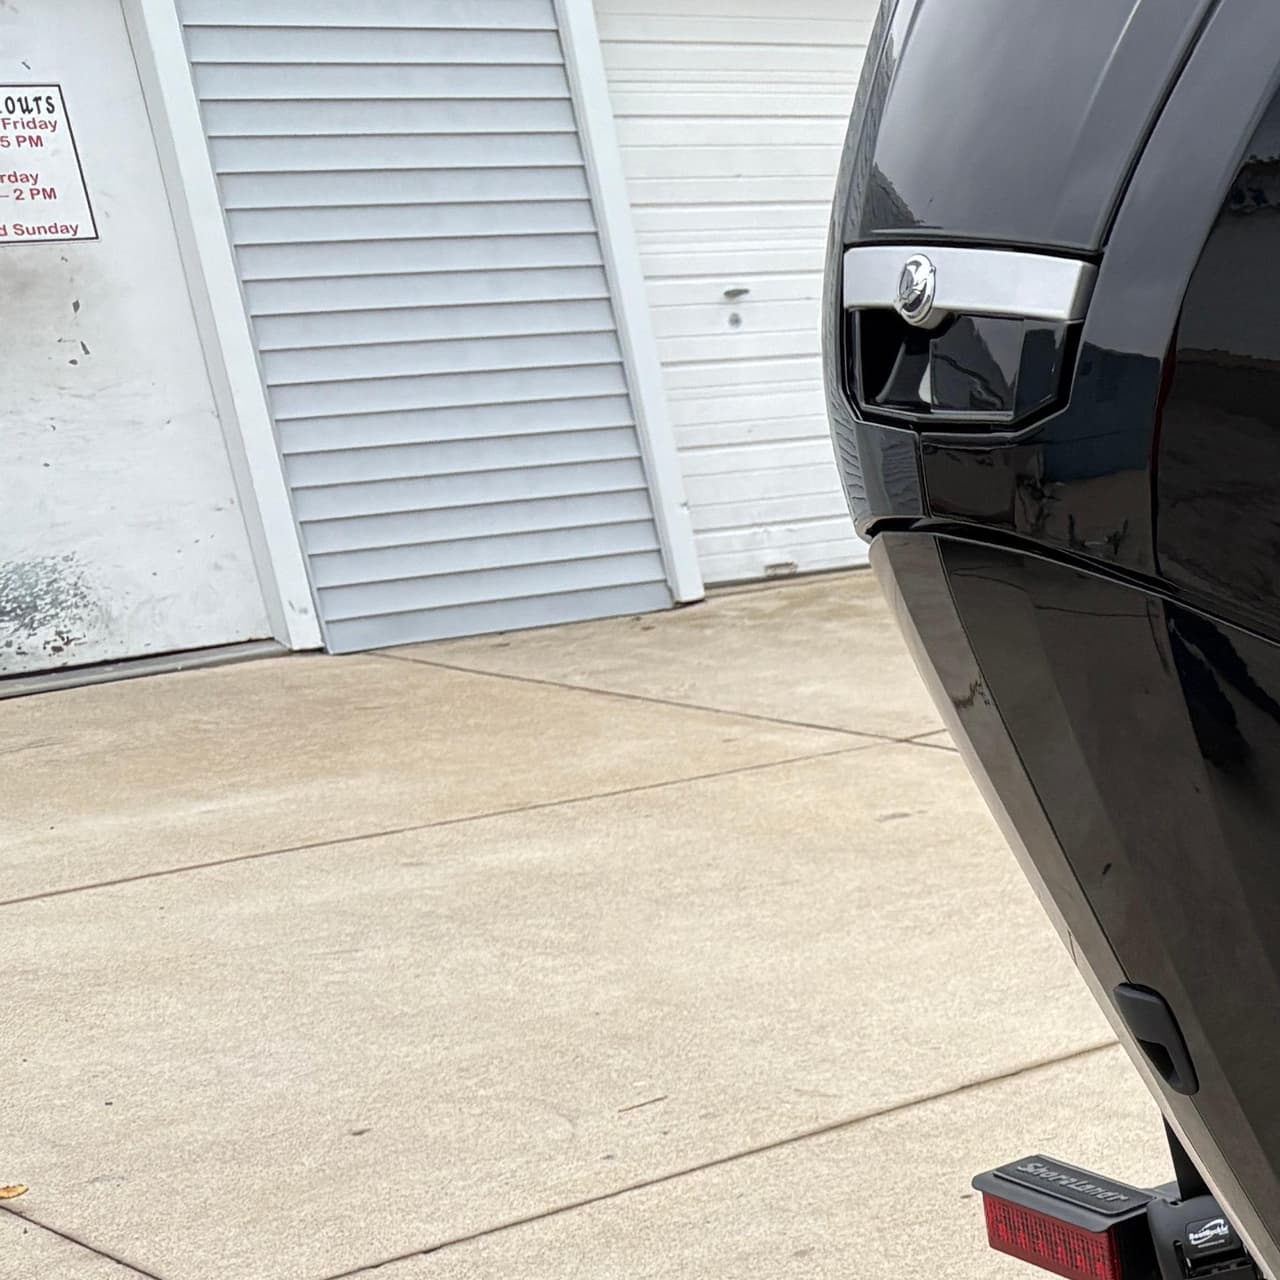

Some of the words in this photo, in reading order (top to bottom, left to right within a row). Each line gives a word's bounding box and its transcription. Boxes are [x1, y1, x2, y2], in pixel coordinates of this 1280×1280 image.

[1, 117, 58, 132] Friday
[0, 136, 11, 148] 5
[16, 135, 44, 148] PM
[13, 188, 25, 201] 2
[29, 187, 57, 201] PM
[13, 223, 79, 237] Sunday
